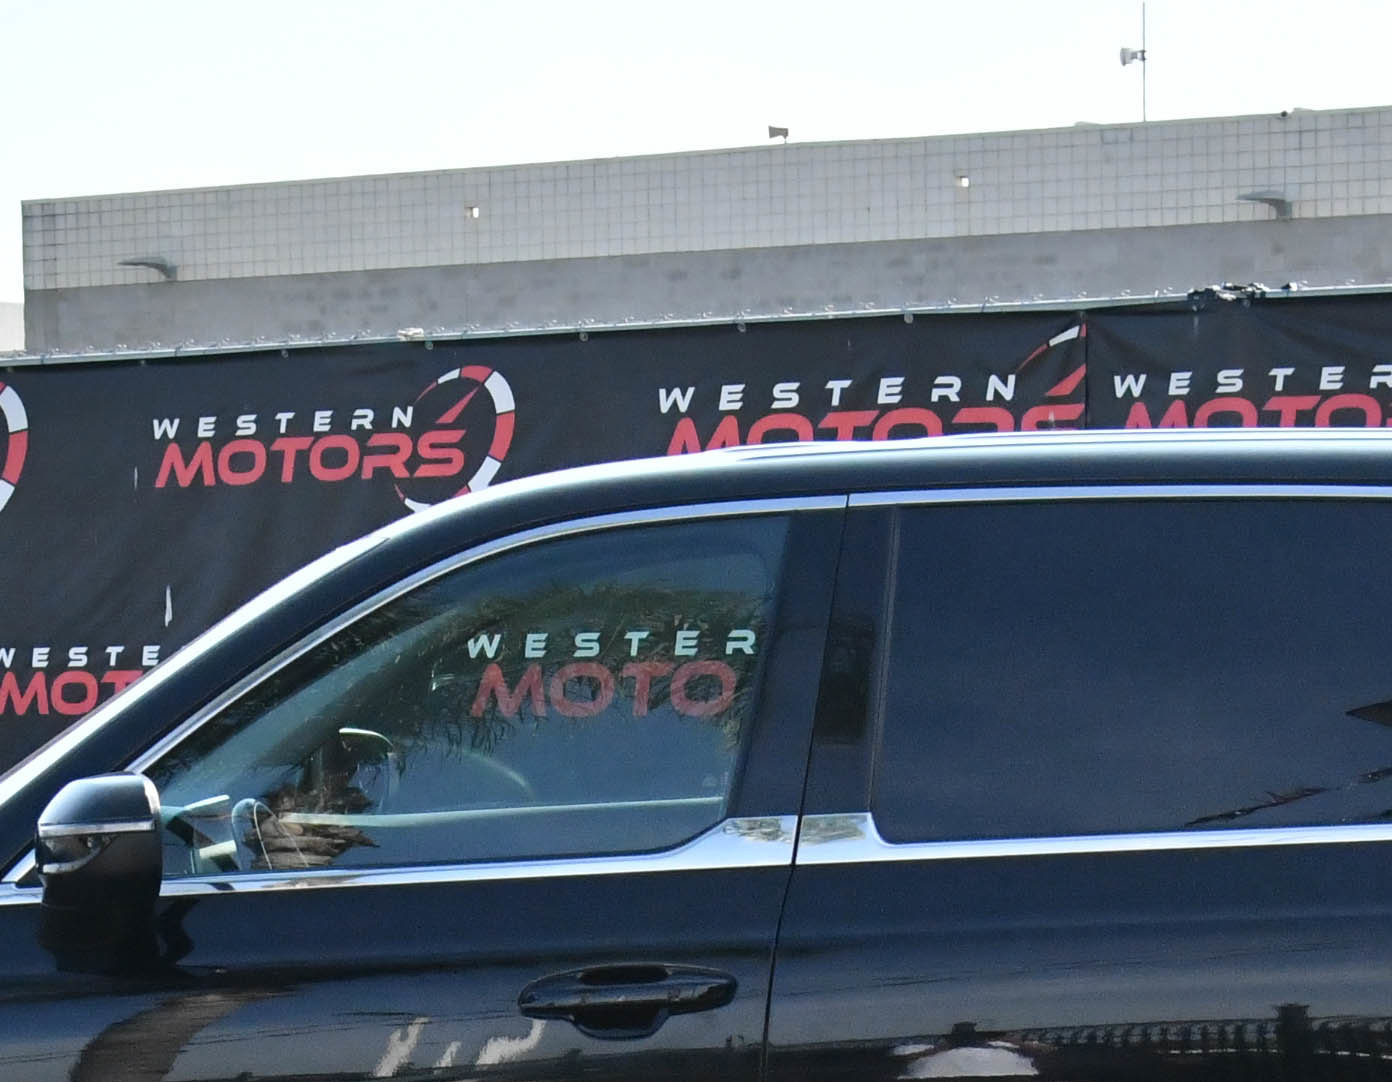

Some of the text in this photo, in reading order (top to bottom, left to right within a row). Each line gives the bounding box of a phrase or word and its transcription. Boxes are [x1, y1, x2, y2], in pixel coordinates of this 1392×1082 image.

[658, 374, 1017, 414] WESTERN
[152, 405, 414, 440] WESTERN
[155, 429, 466, 489] MOTORS
